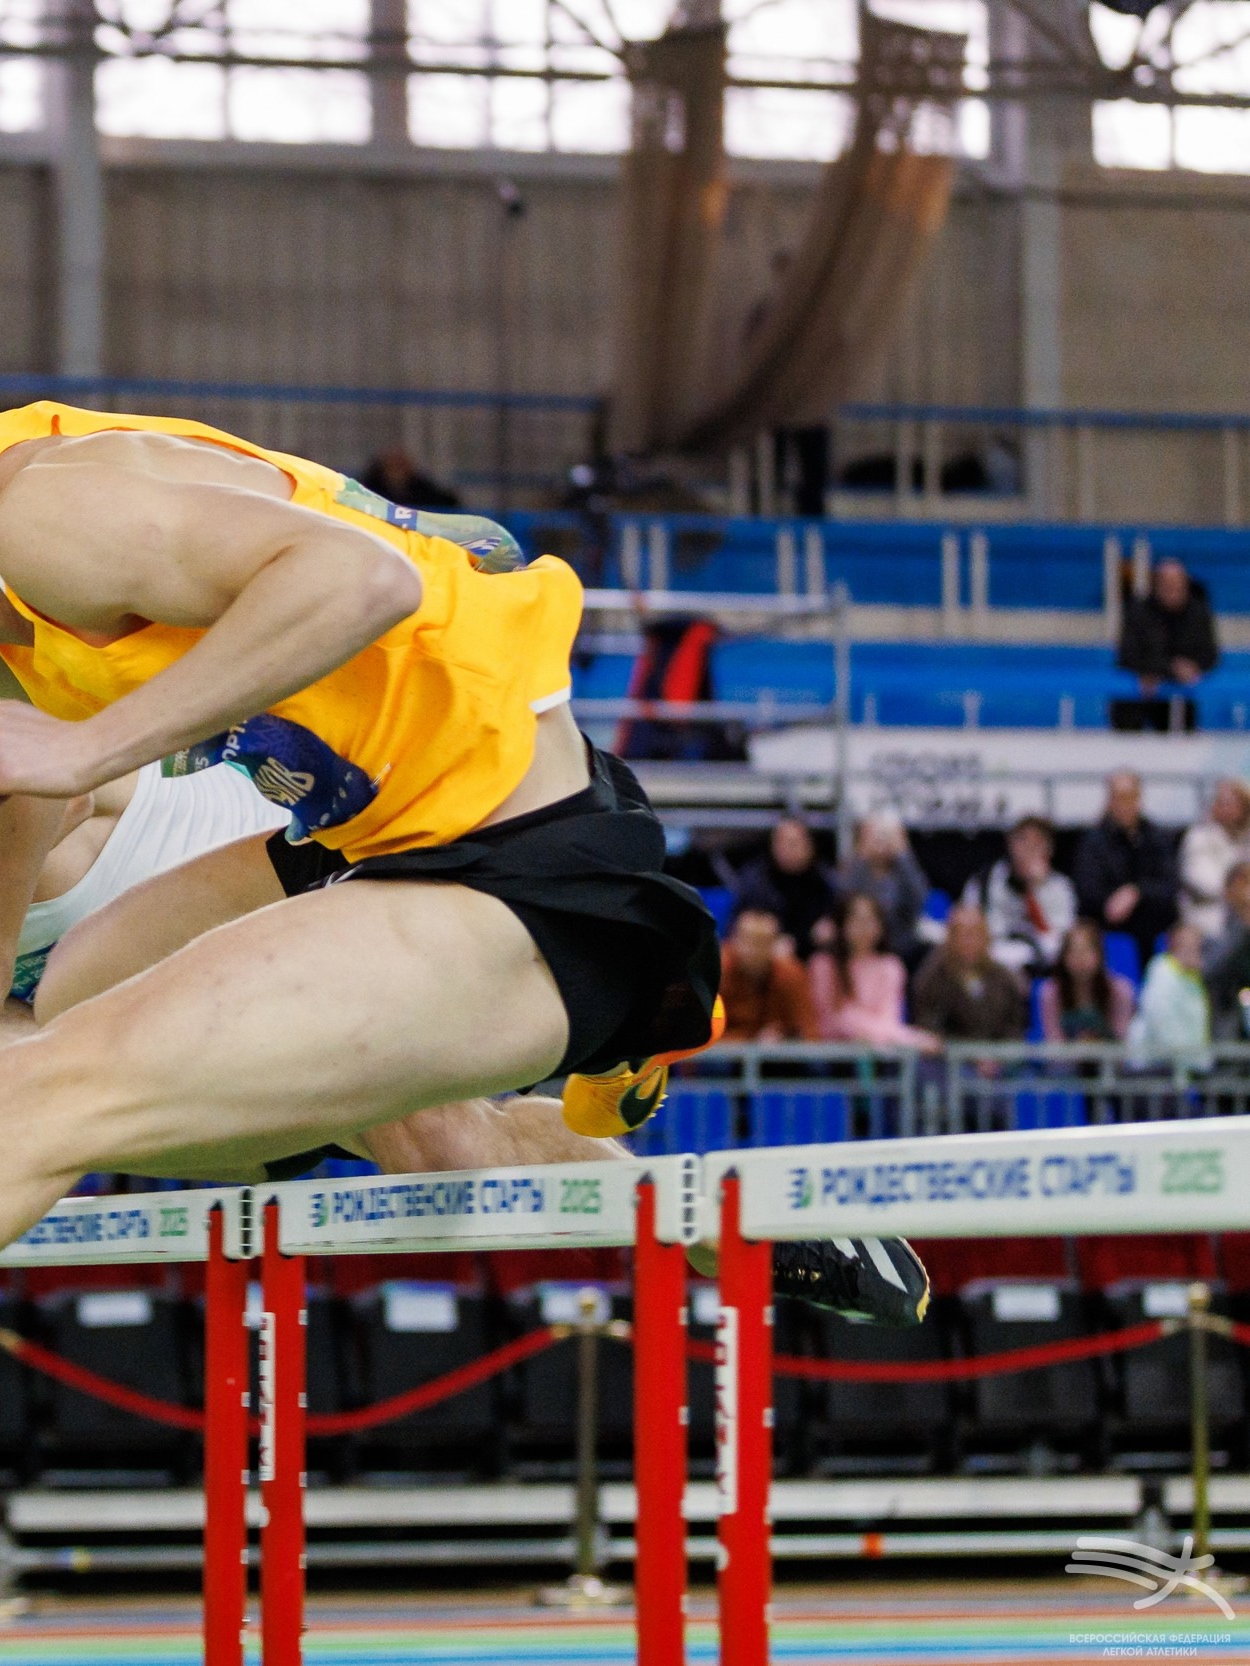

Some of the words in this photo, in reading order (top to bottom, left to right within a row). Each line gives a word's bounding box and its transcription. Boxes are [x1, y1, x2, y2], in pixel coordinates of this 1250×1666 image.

[1041, 1154, 1136, 1197] СТАРТЫ
[1161, 1149, 1223, 1194] 2025
[482, 1178, 545, 1214] СТАРТЫ
[560, 1178, 601, 1214] 2025
